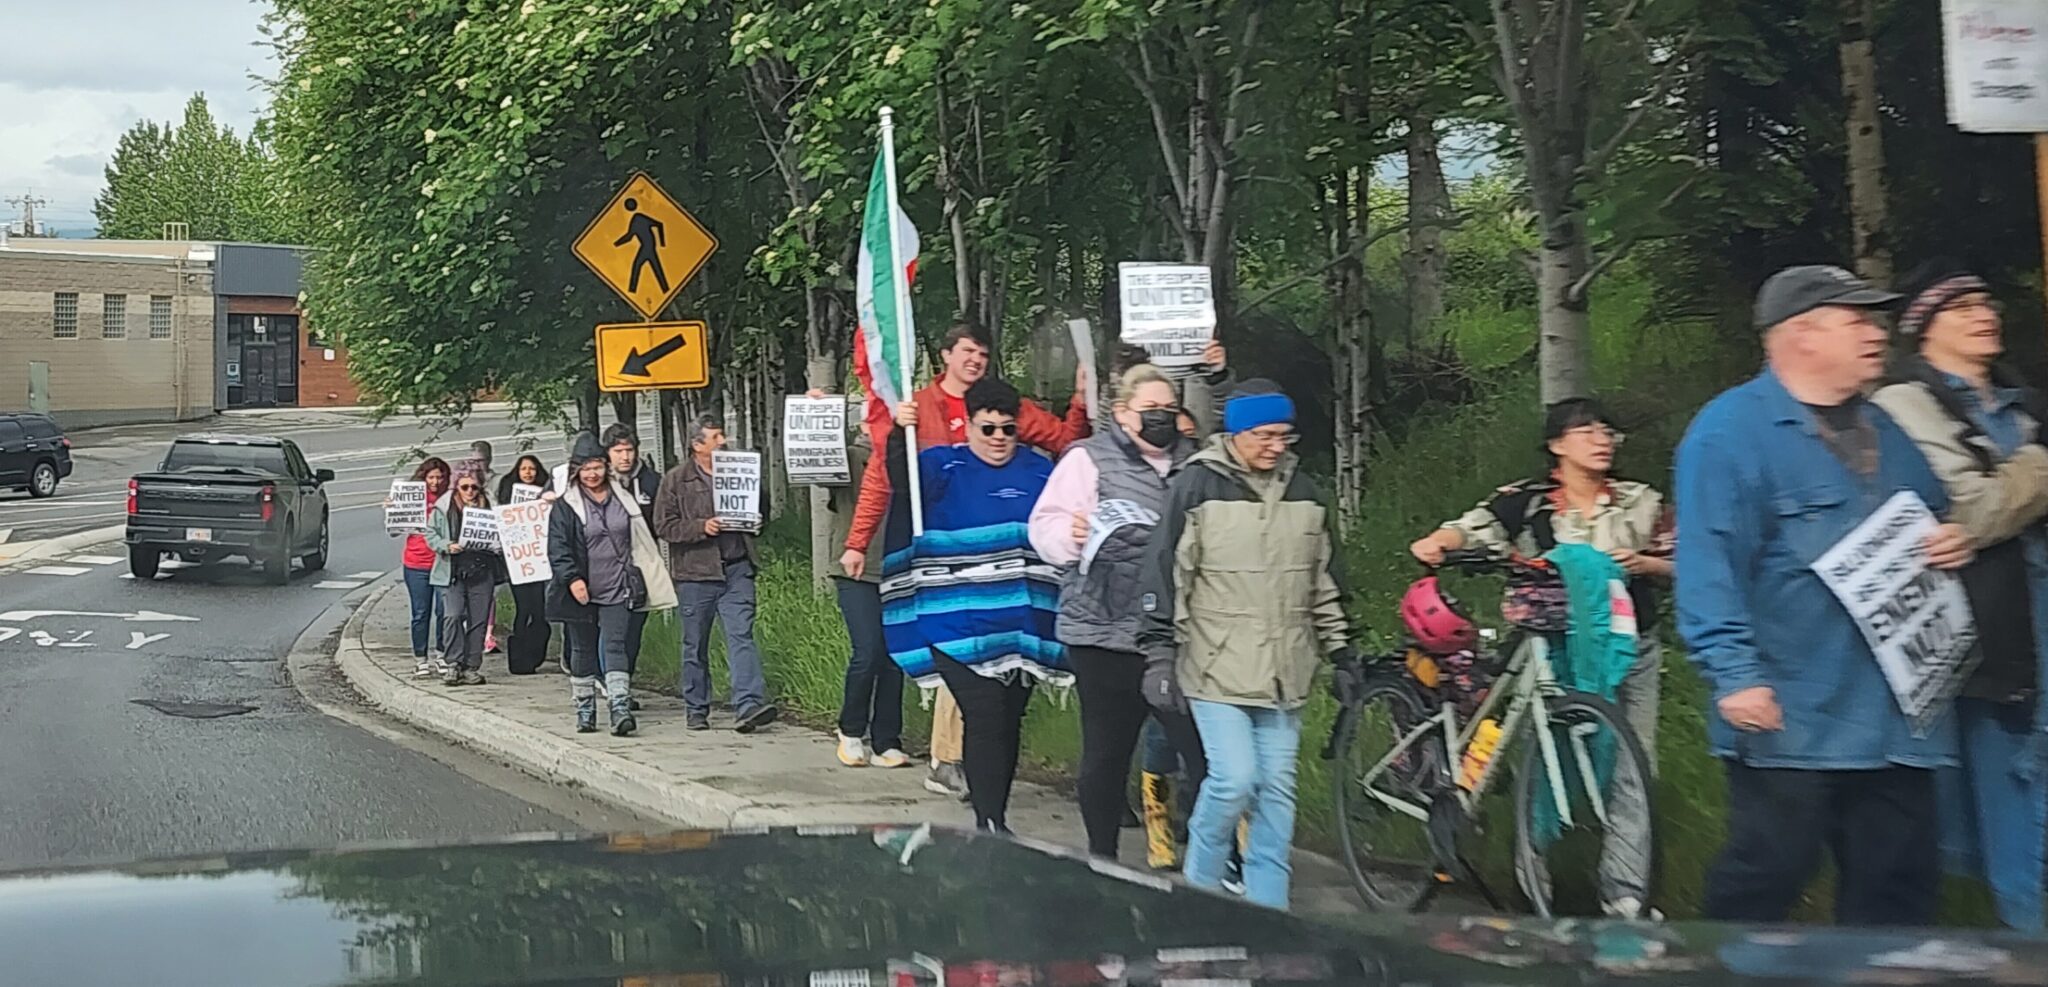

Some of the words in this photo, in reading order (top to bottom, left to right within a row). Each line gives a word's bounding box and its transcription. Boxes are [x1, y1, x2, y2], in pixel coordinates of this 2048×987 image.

[1128, 287, 1208, 306] UNITED
[790, 404, 805, 413] THE
[808, 404, 842, 413] PEOPLE
[789, 415, 841, 430] UNITED
[715, 477, 758, 490] ENEMY
[719, 495, 748, 510] NOT
[502, 502, 549, 525] STOP
[465, 540, 493, 549] NOT
[511, 541, 544, 561] DUE
[521, 562, 535, 577] IS
